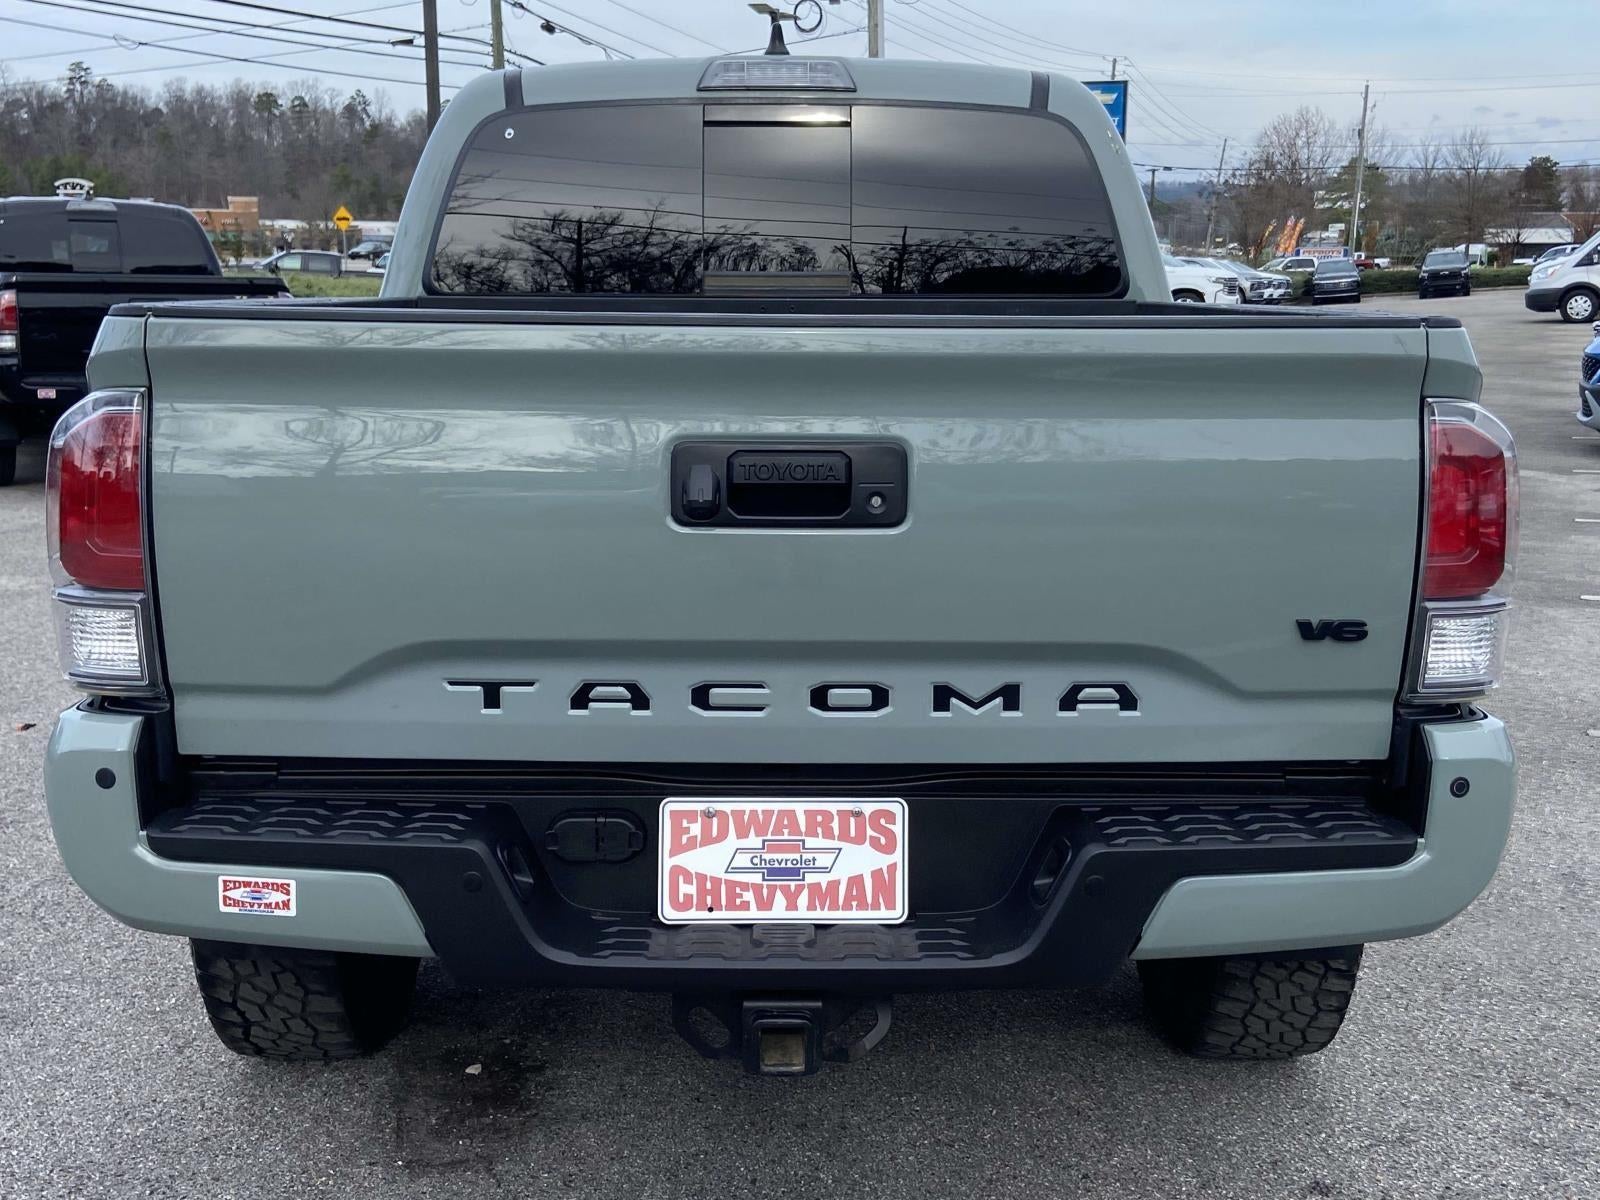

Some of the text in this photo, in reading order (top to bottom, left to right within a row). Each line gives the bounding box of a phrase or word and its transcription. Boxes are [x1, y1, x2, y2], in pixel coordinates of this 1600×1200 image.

[739, 462, 841, 481] TOYOTA
[1295, 619, 1369, 641] V6
[442, 679, 1142, 717] TACOMA
[669, 809, 898, 858] EDWARDS
[750, 855, 817, 867] Chevrolet
[222, 880, 291, 896] EDWARDS
[668, 862, 898, 912] CHEVYMAN
[222, 894, 291, 911] CHEVYMAN
